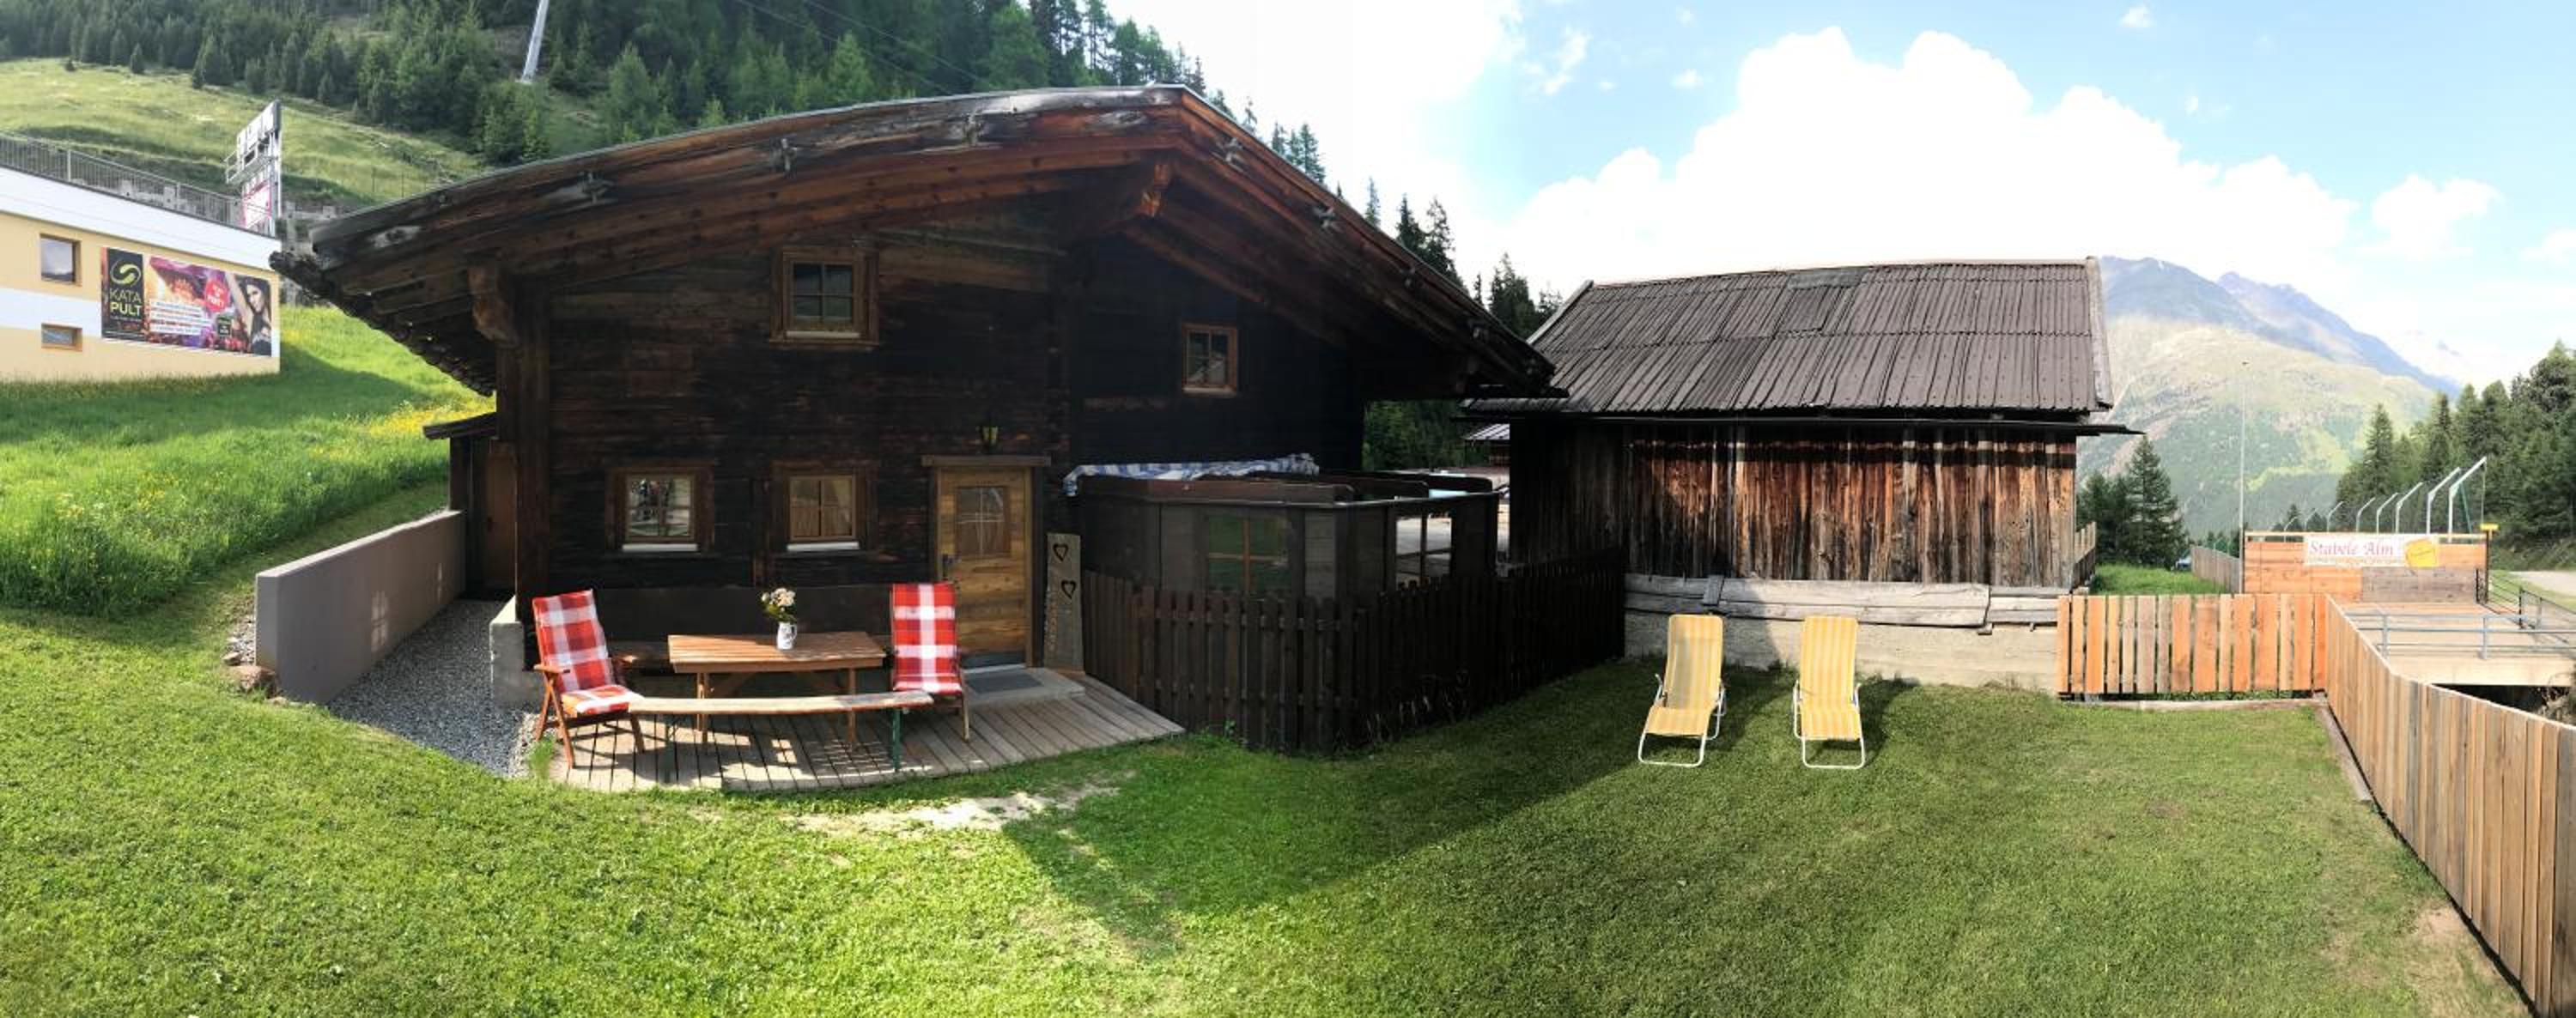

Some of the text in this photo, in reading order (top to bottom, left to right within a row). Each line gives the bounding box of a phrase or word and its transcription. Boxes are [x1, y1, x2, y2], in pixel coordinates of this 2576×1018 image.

[109, 288, 141, 303] KATA
[110, 302, 143, 316] PULT
[2310, 540, 2358, 555] Stabele
[2364, 540, 2393, 555] Alm
